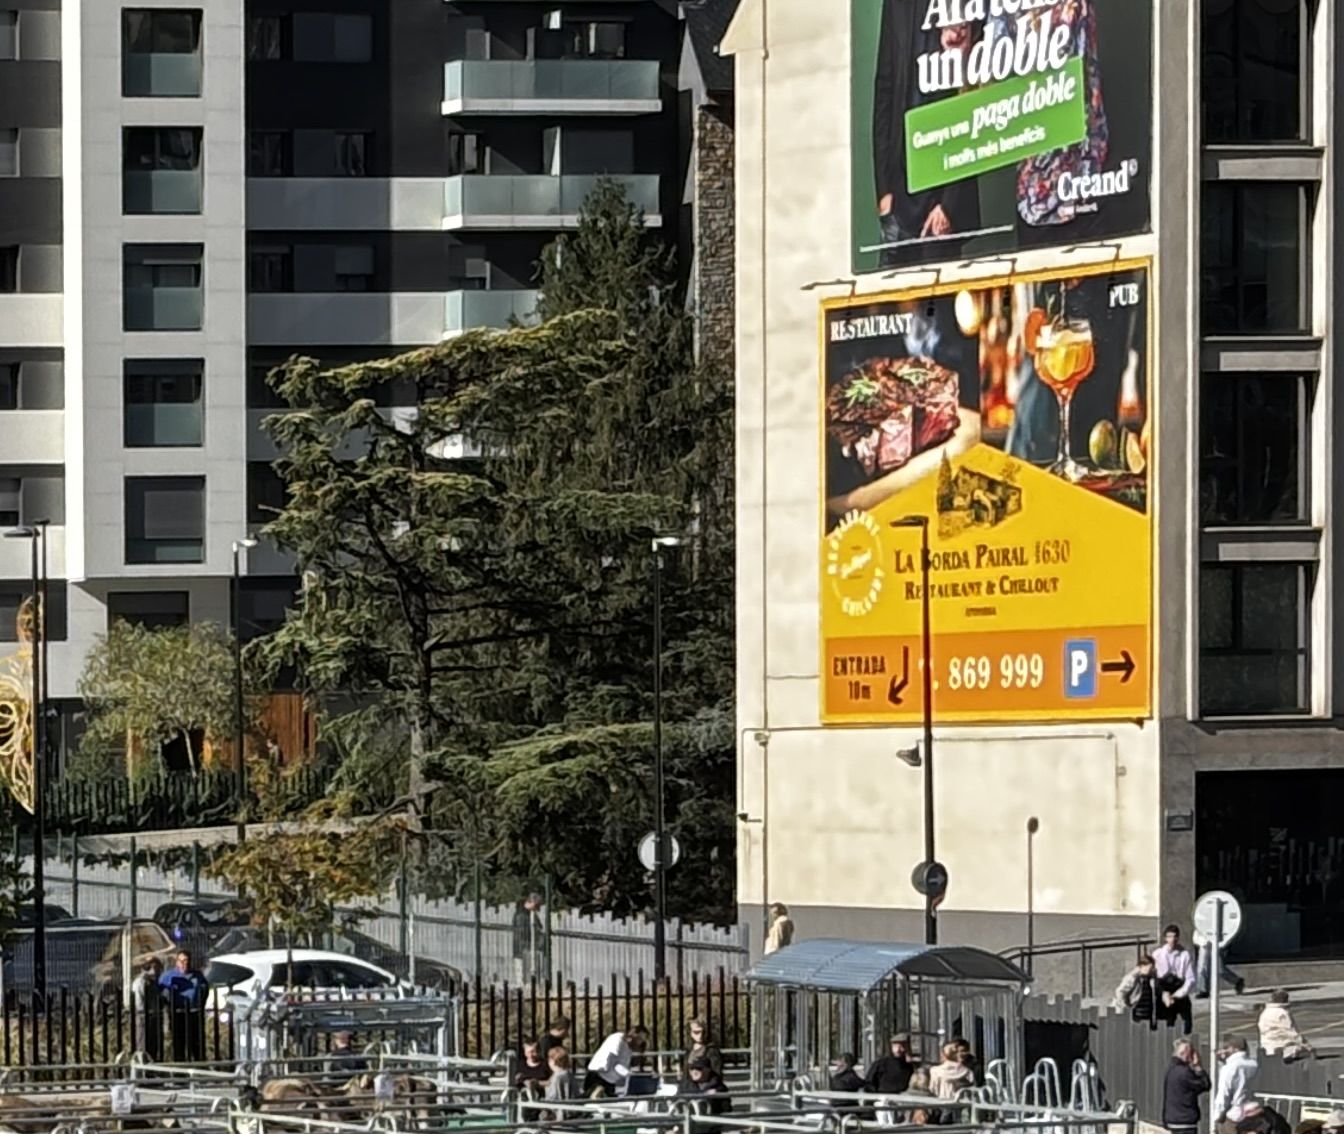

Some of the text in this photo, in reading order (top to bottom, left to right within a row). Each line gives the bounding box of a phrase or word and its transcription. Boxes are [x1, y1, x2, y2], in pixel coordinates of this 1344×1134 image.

[917, 9, 1070, 93] un doble
[971, 94, 1020, 139] paga
[1021, 72, 1076, 115] doble
[1109, 283, 1139, 307] PUB
[830, 312, 913, 341] RESTAURANT
[1035, 539, 1070, 564] 1630
[905, 580, 983, 600] RETAURANT
[833, 655, 886, 676] ENTRADA
[948, 656, 991, 690] 869
[1000, 653, 1043, 689] 999
[1070, 649, 1088, 687] P
